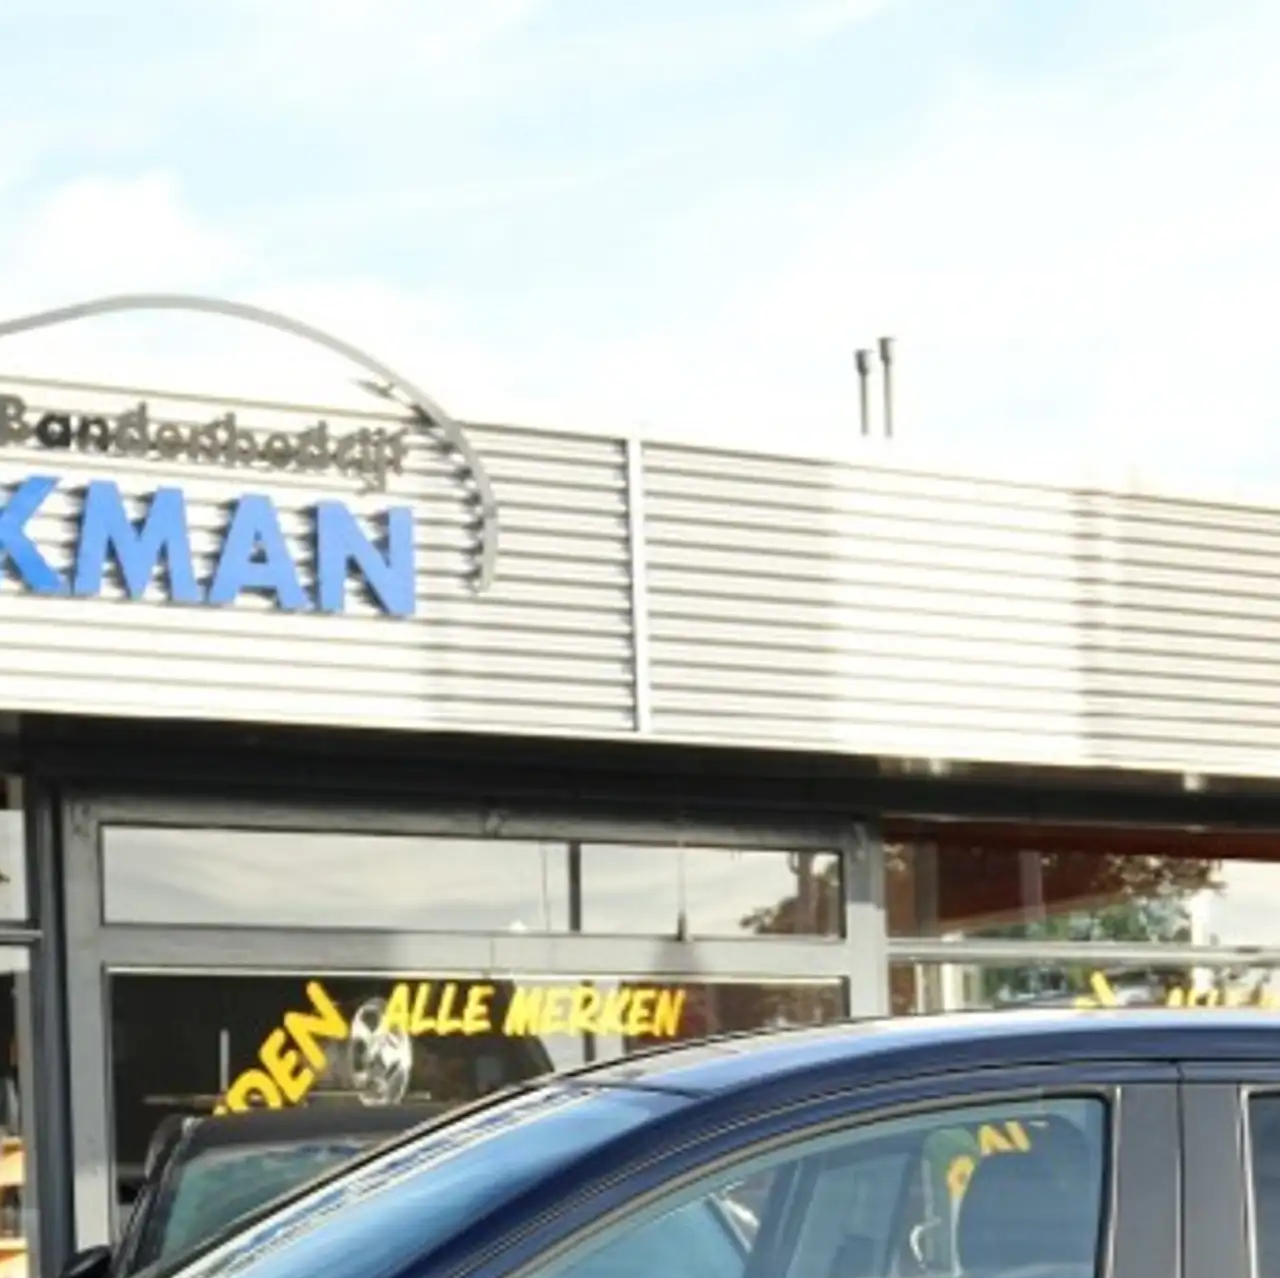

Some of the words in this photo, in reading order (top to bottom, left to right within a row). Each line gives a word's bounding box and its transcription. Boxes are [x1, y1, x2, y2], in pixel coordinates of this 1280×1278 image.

[213, 980, 348, 1116] DEN
[380, 982, 496, 1036] ALLE
[504, 984, 686, 1038] MERKEN
